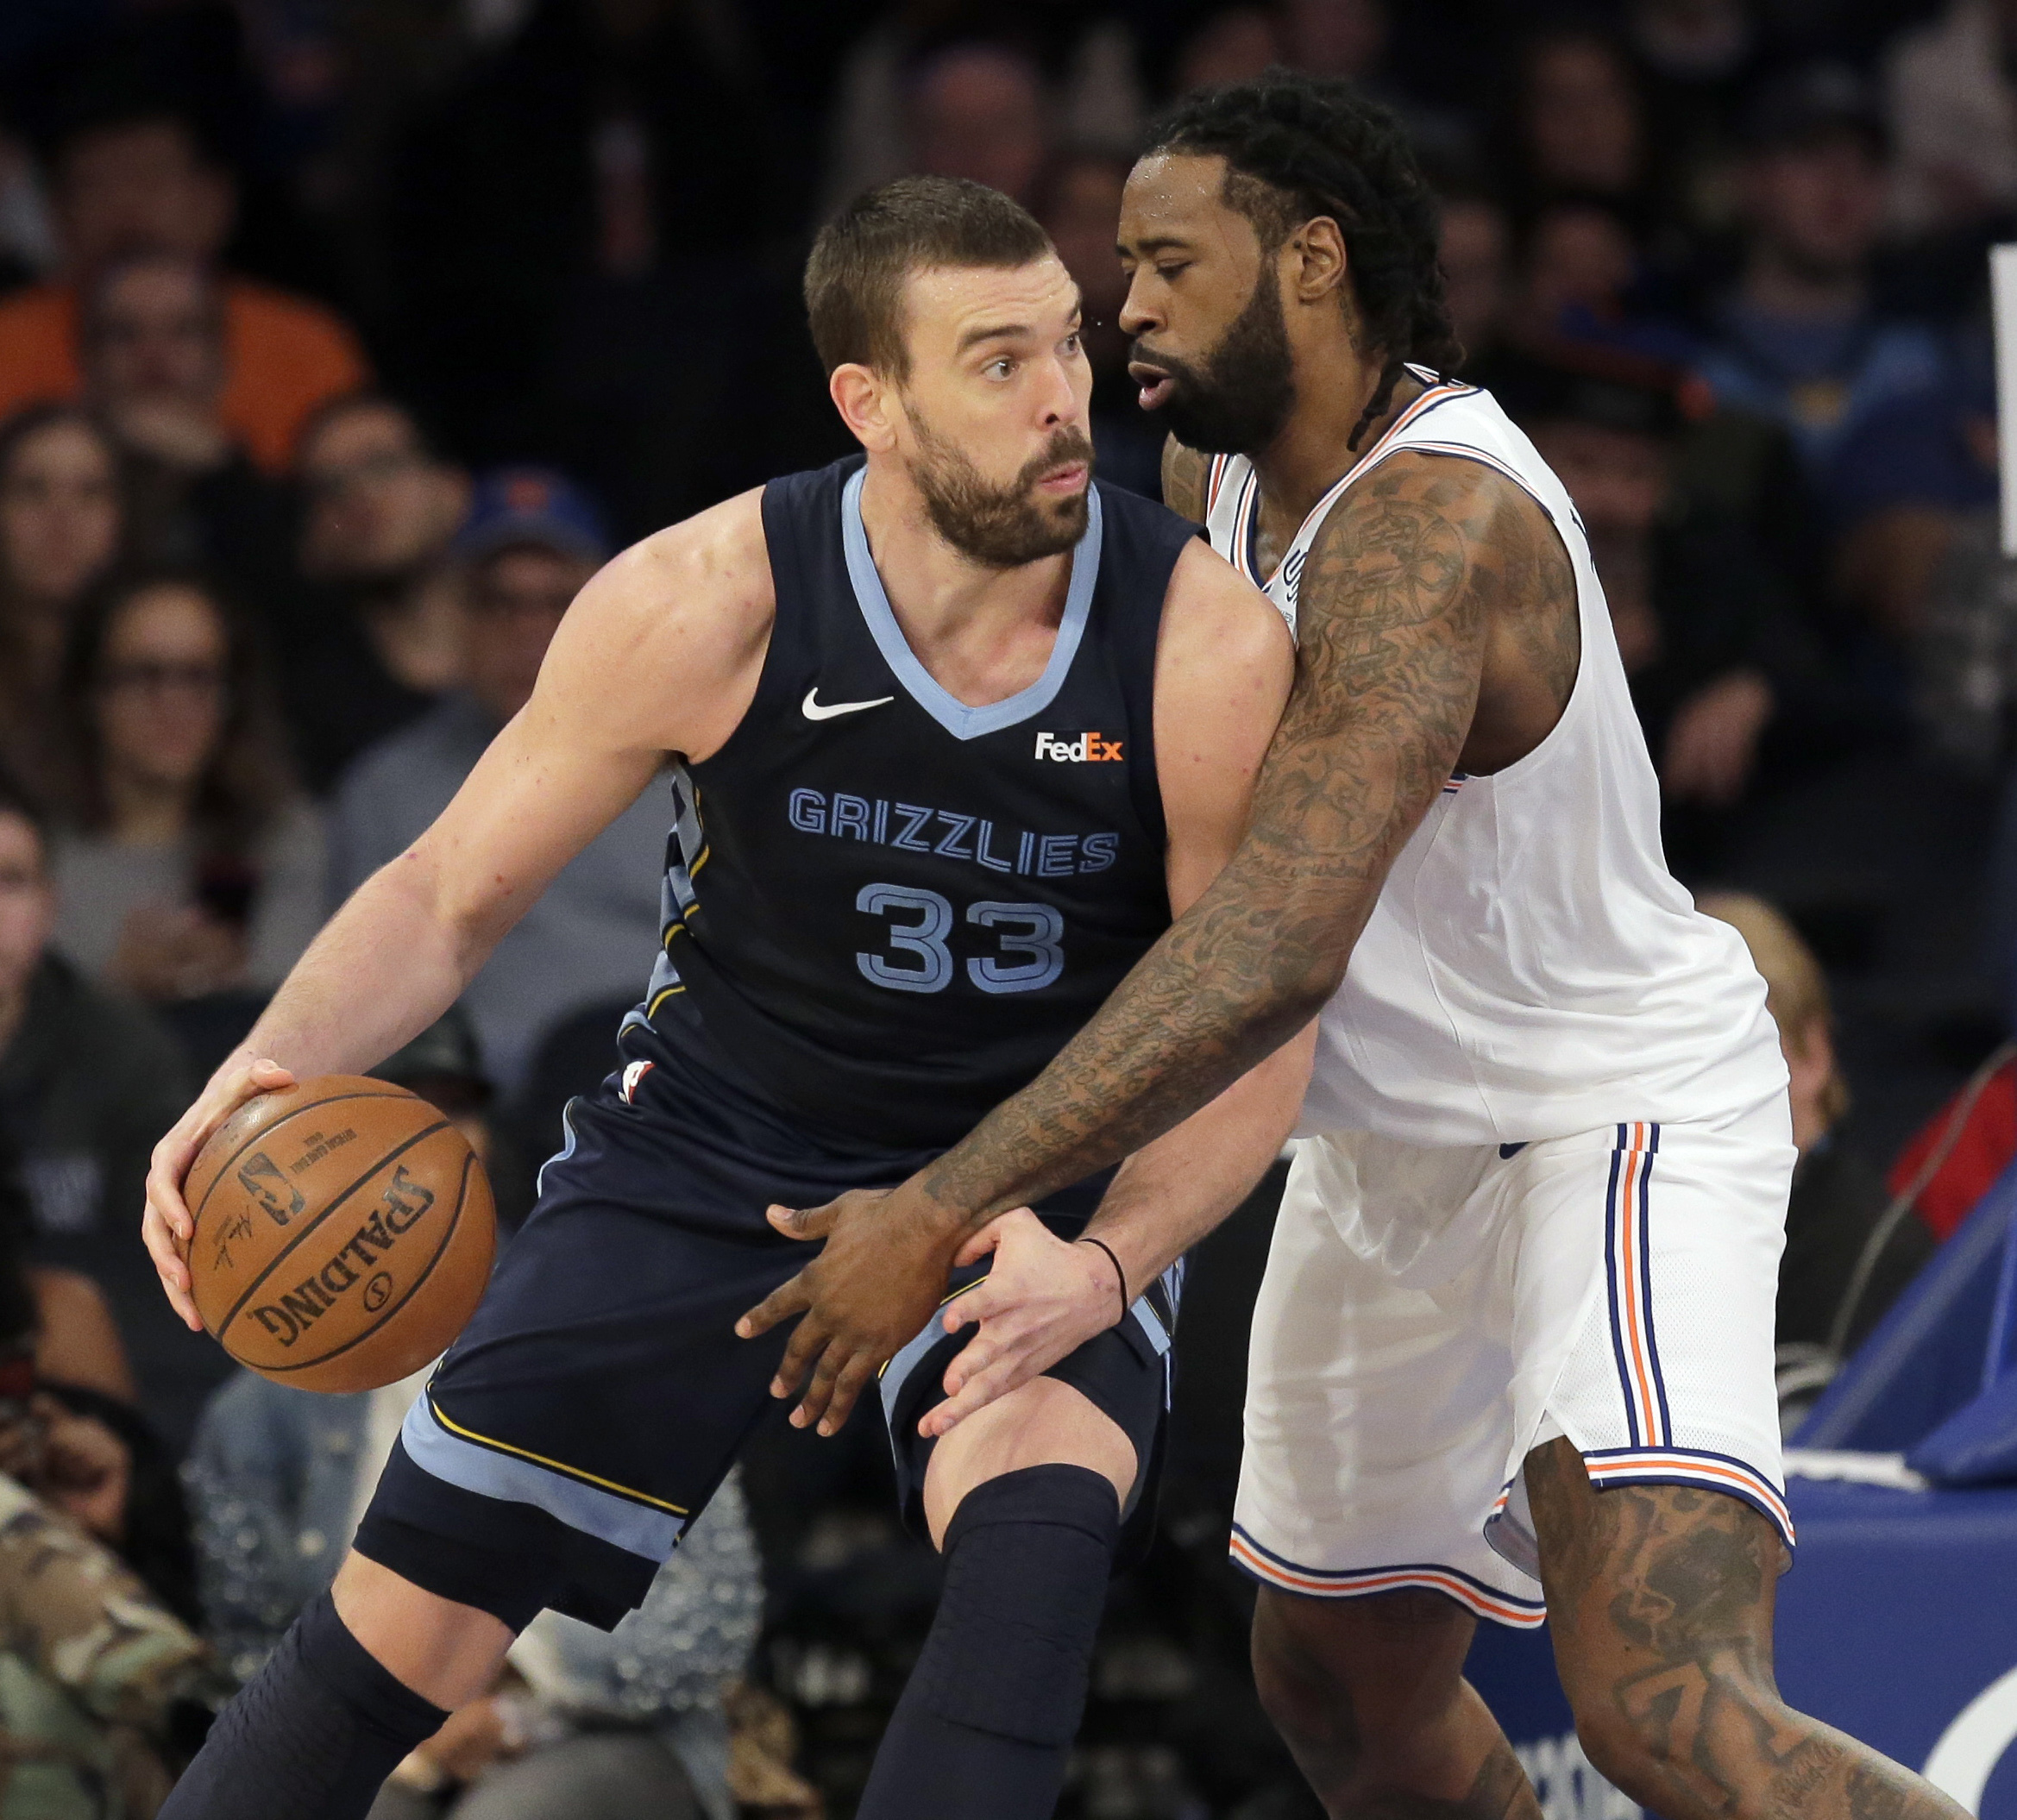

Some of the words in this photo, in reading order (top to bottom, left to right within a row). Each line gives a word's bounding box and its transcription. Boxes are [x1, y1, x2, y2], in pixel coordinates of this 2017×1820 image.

[1034, 731, 1123, 763] FedEx
[789, 788, 1120, 877] GRIZZLIES
[856, 882, 1065, 994] 33
[252, 1165, 435, 1347] SPALDING
